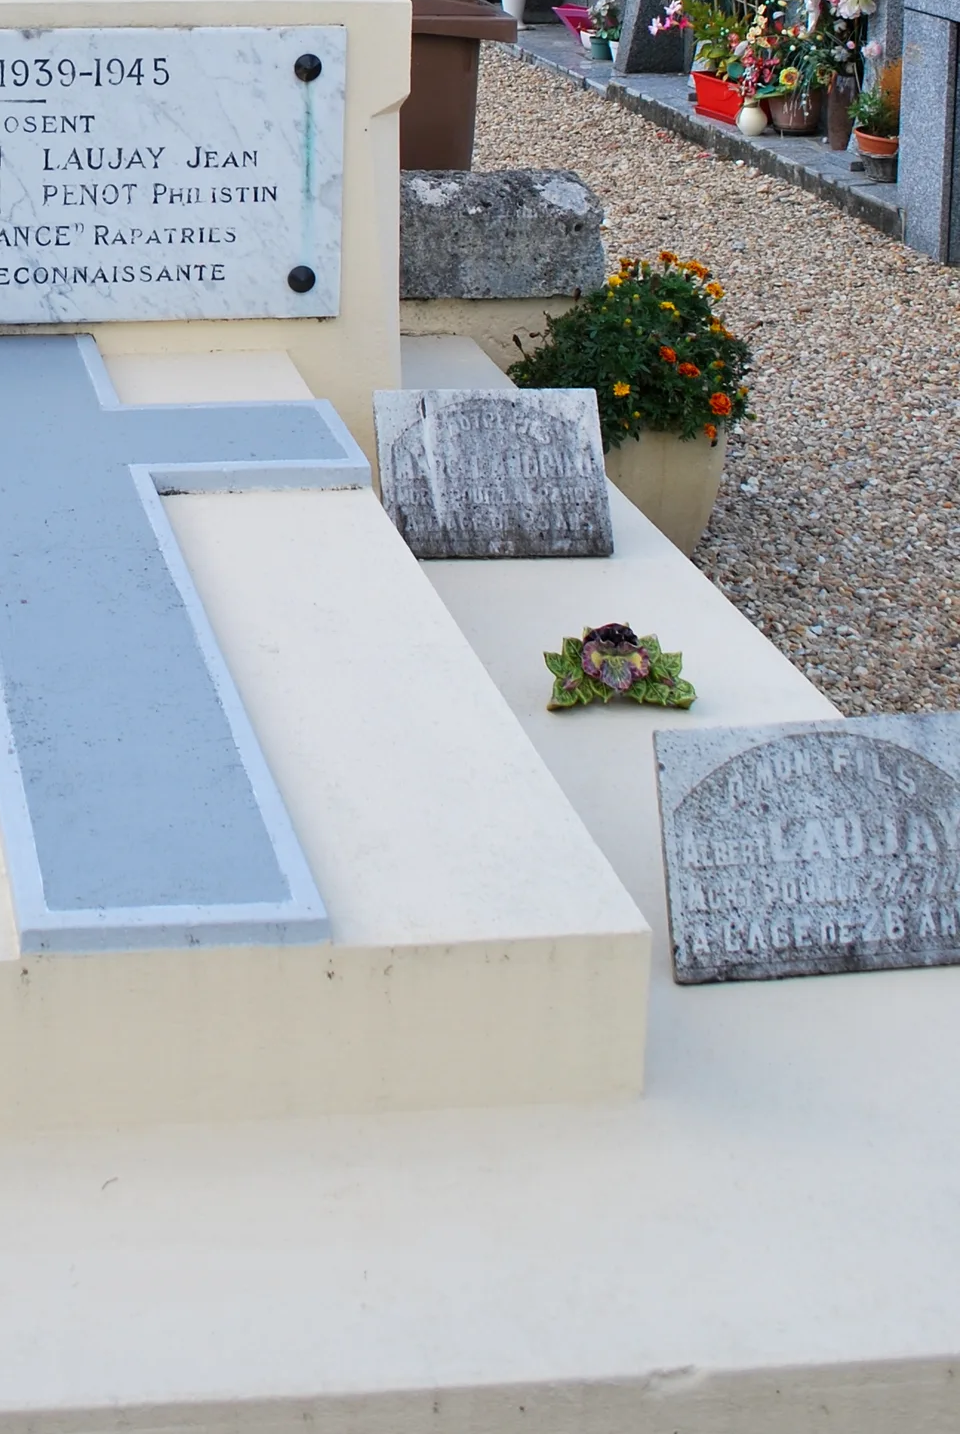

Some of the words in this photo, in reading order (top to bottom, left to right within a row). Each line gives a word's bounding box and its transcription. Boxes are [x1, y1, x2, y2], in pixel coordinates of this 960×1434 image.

[42, 146, 166, 171] LAUJAY
[186, 145, 259, 170] JEAN
[41, 182, 138, 207] PENOT
[152, 182, 278, 206] PHILISTIN
[756, 749, 813, 790] MON
[832, 747, 916, 796] FILS
[770, 808, 960, 863] LAUJAY
[821, 915, 856, 945] DE
